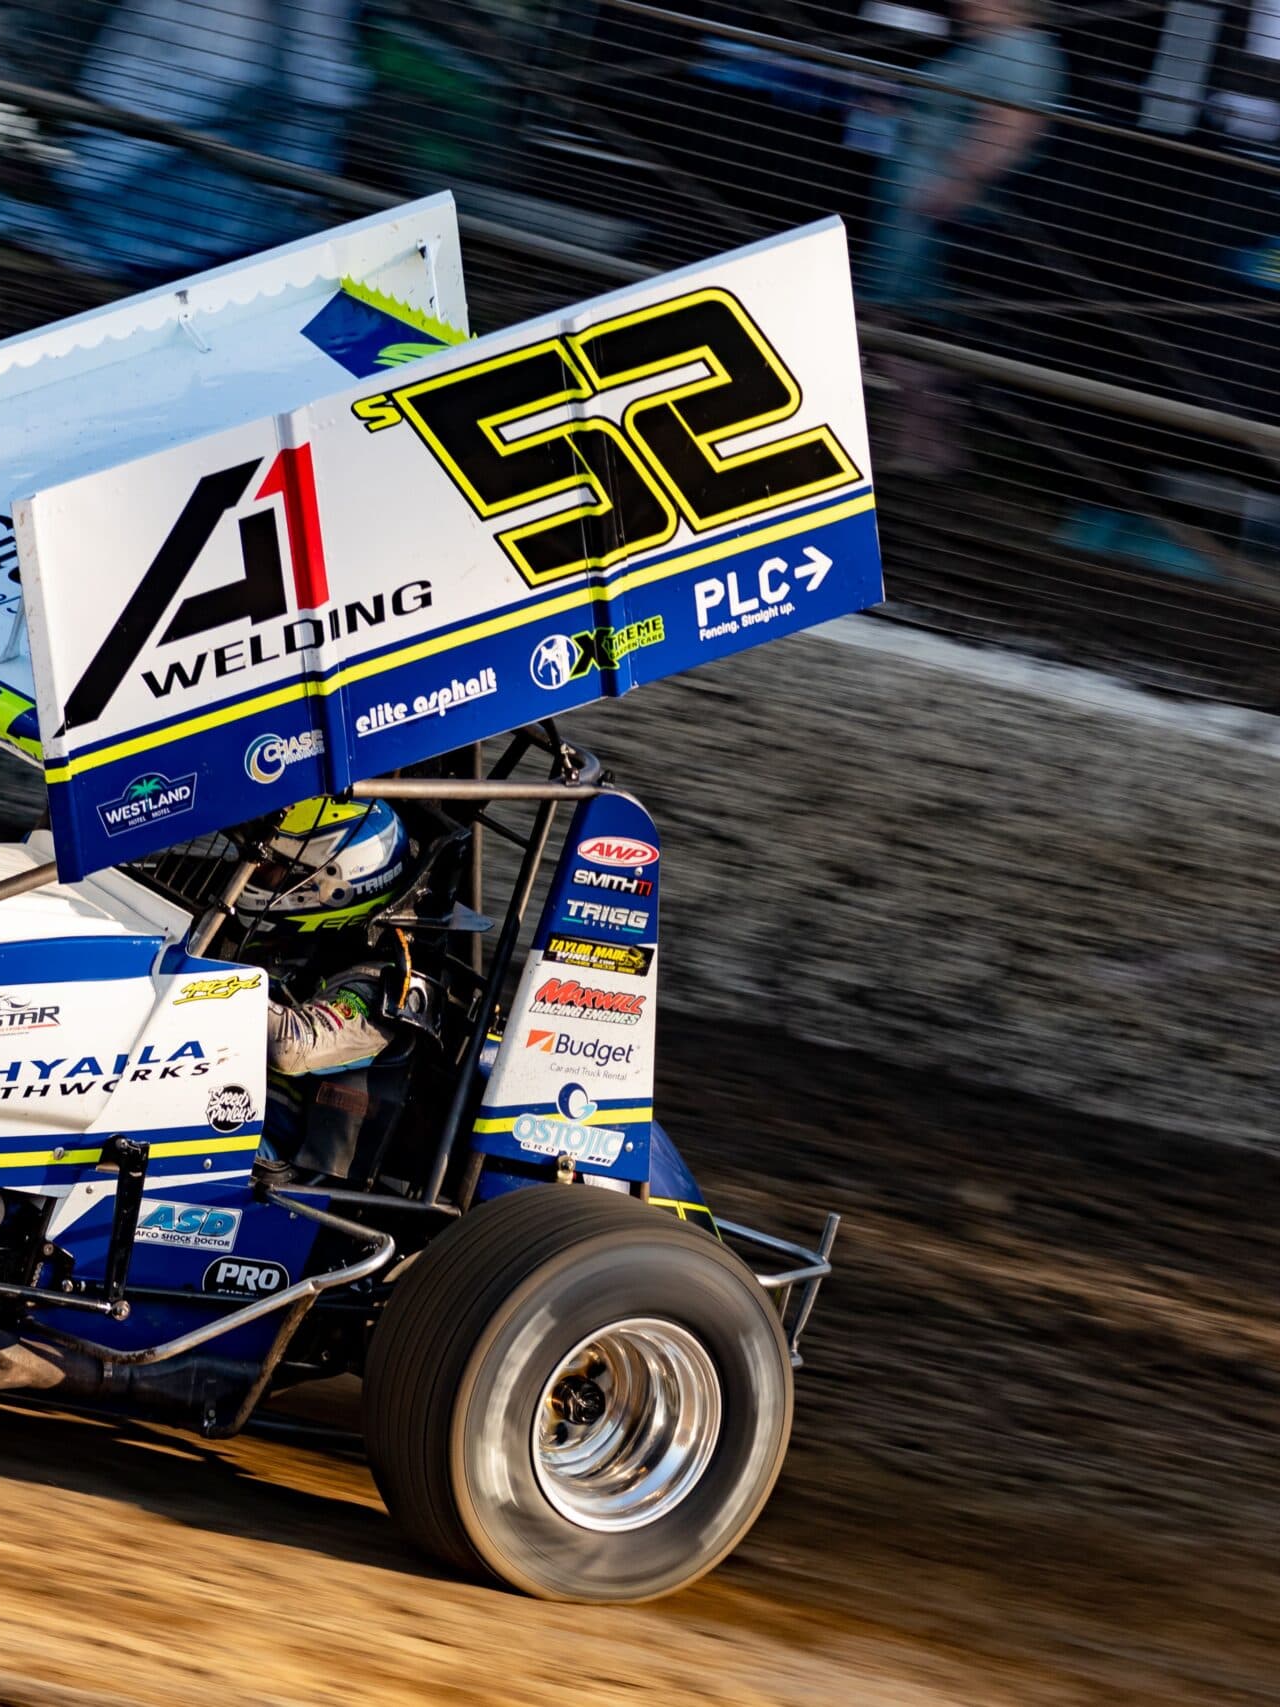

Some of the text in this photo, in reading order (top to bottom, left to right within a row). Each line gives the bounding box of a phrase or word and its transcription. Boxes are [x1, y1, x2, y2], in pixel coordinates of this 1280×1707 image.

[392, 286, 864, 589] 52
[52, 442, 330, 738] A1
[694, 557, 791, 628] PLC
[141, 580, 432, 698] WELDING
[355, 667, 498, 734] elite asphalt
[105, 785, 191, 825] WESTLAND
[583, 842, 649, 860] AWP
[567, 899, 650, 929] TRIGG
[549, 939, 629, 961] TAYLOR MADE
[529, 1001, 641, 1025] RACING ENGINES
[535, 978, 647, 1014] MAXWILL
[555, 1033, 634, 1067] Budget
[549, 1063, 627, 1081] Car and Truck Rental
[513, 1115, 621, 1158] OSTOJIC
[522, 1142, 578, 1158] GROP
[137, 1204, 237, 1238] ASD
[135, 1230, 159, 1239] AFCO
[161, 1233, 191, 1243] SHOCK
[194, 1236, 231, 1247] DOCTOR
[215, 1262, 281, 1291] PRO
